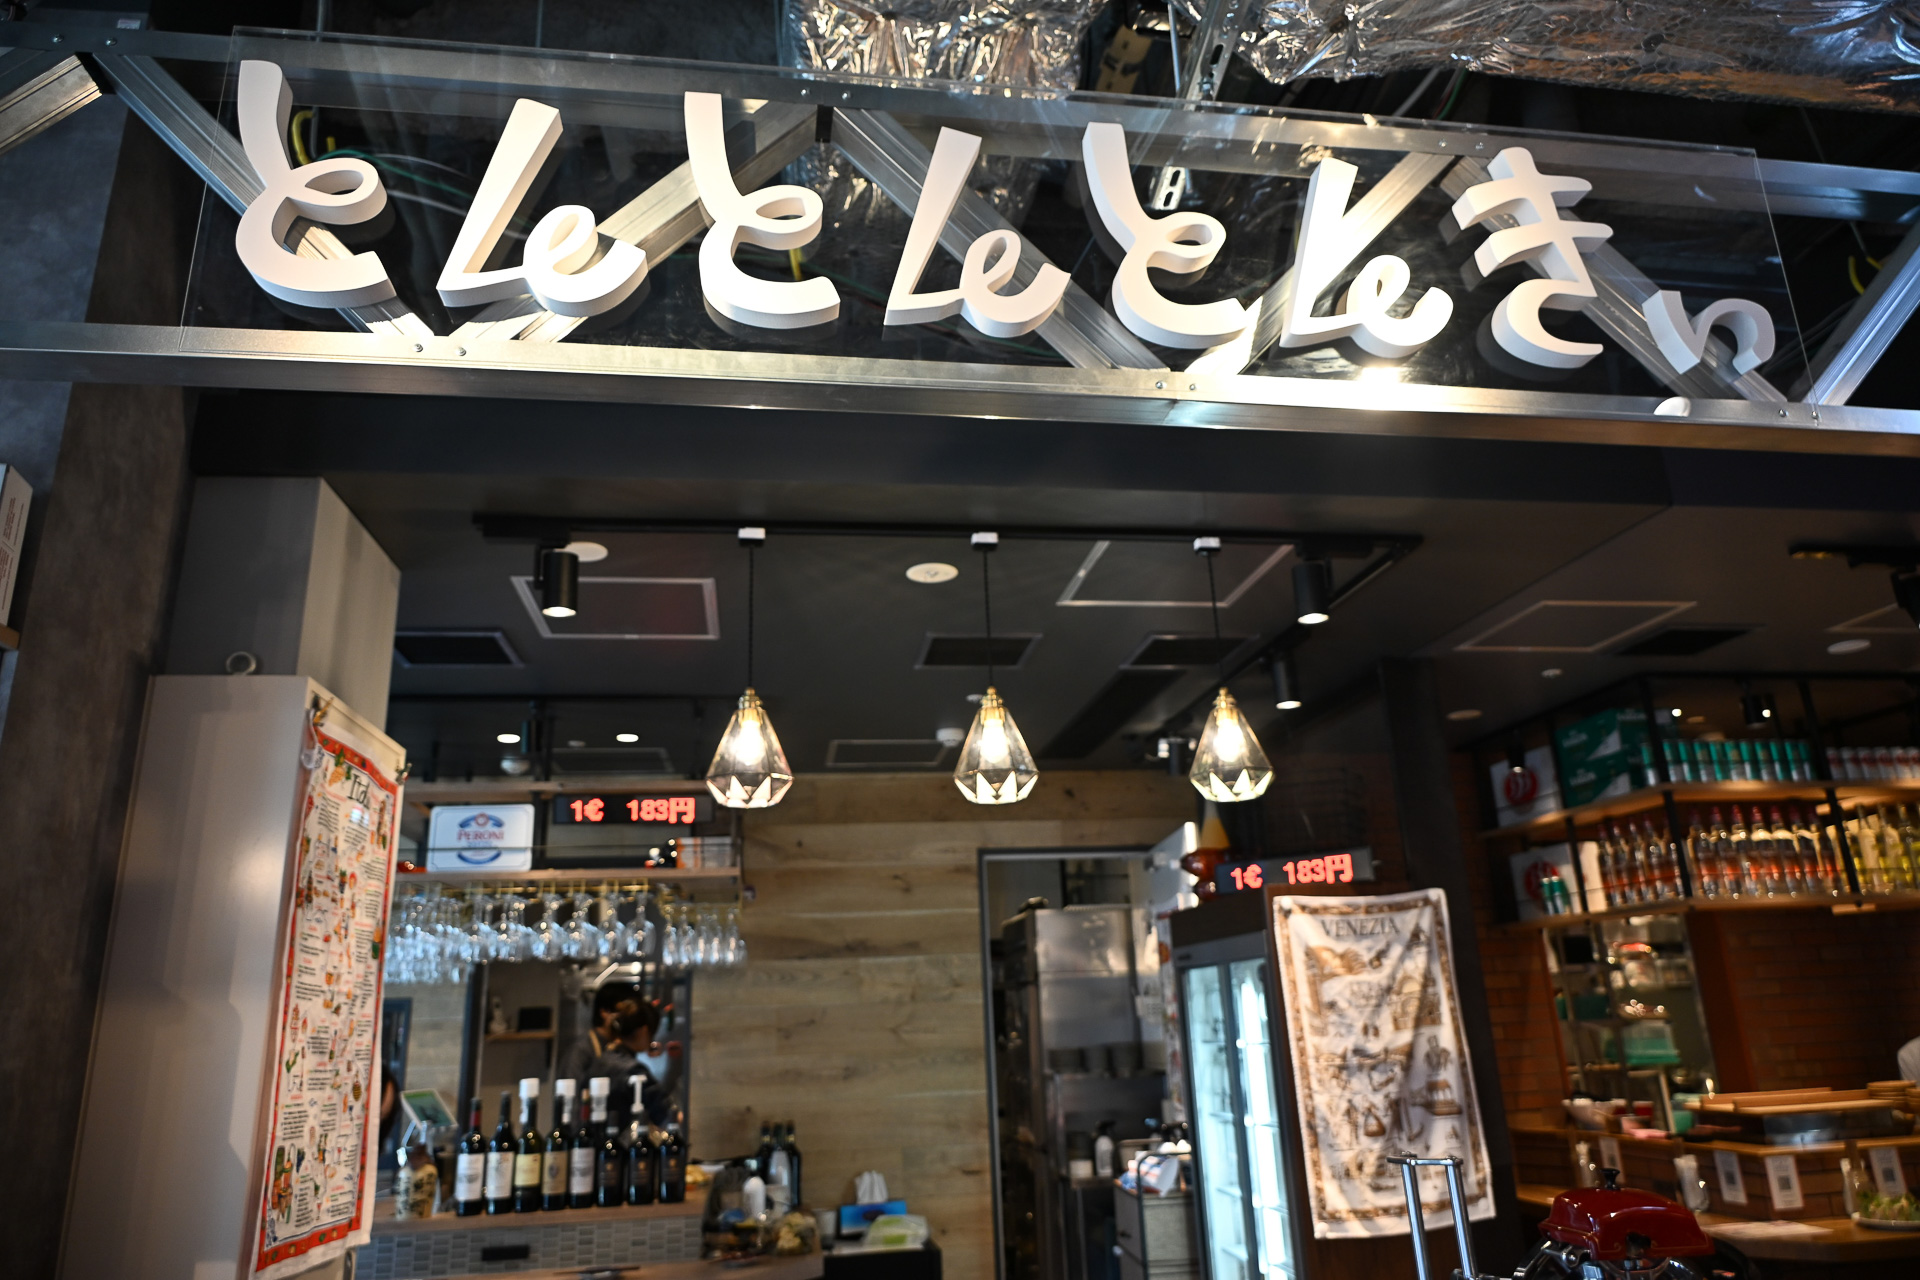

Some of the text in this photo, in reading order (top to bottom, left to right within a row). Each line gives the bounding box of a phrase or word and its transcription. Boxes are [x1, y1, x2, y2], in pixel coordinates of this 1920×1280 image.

[570, 797, 696, 824] 1€ 183円
[456, 829, 505, 842] PERONI
[1230, 853, 1354, 891] 1€ 183円
[1320, 916, 1401, 938] VENEZIA
